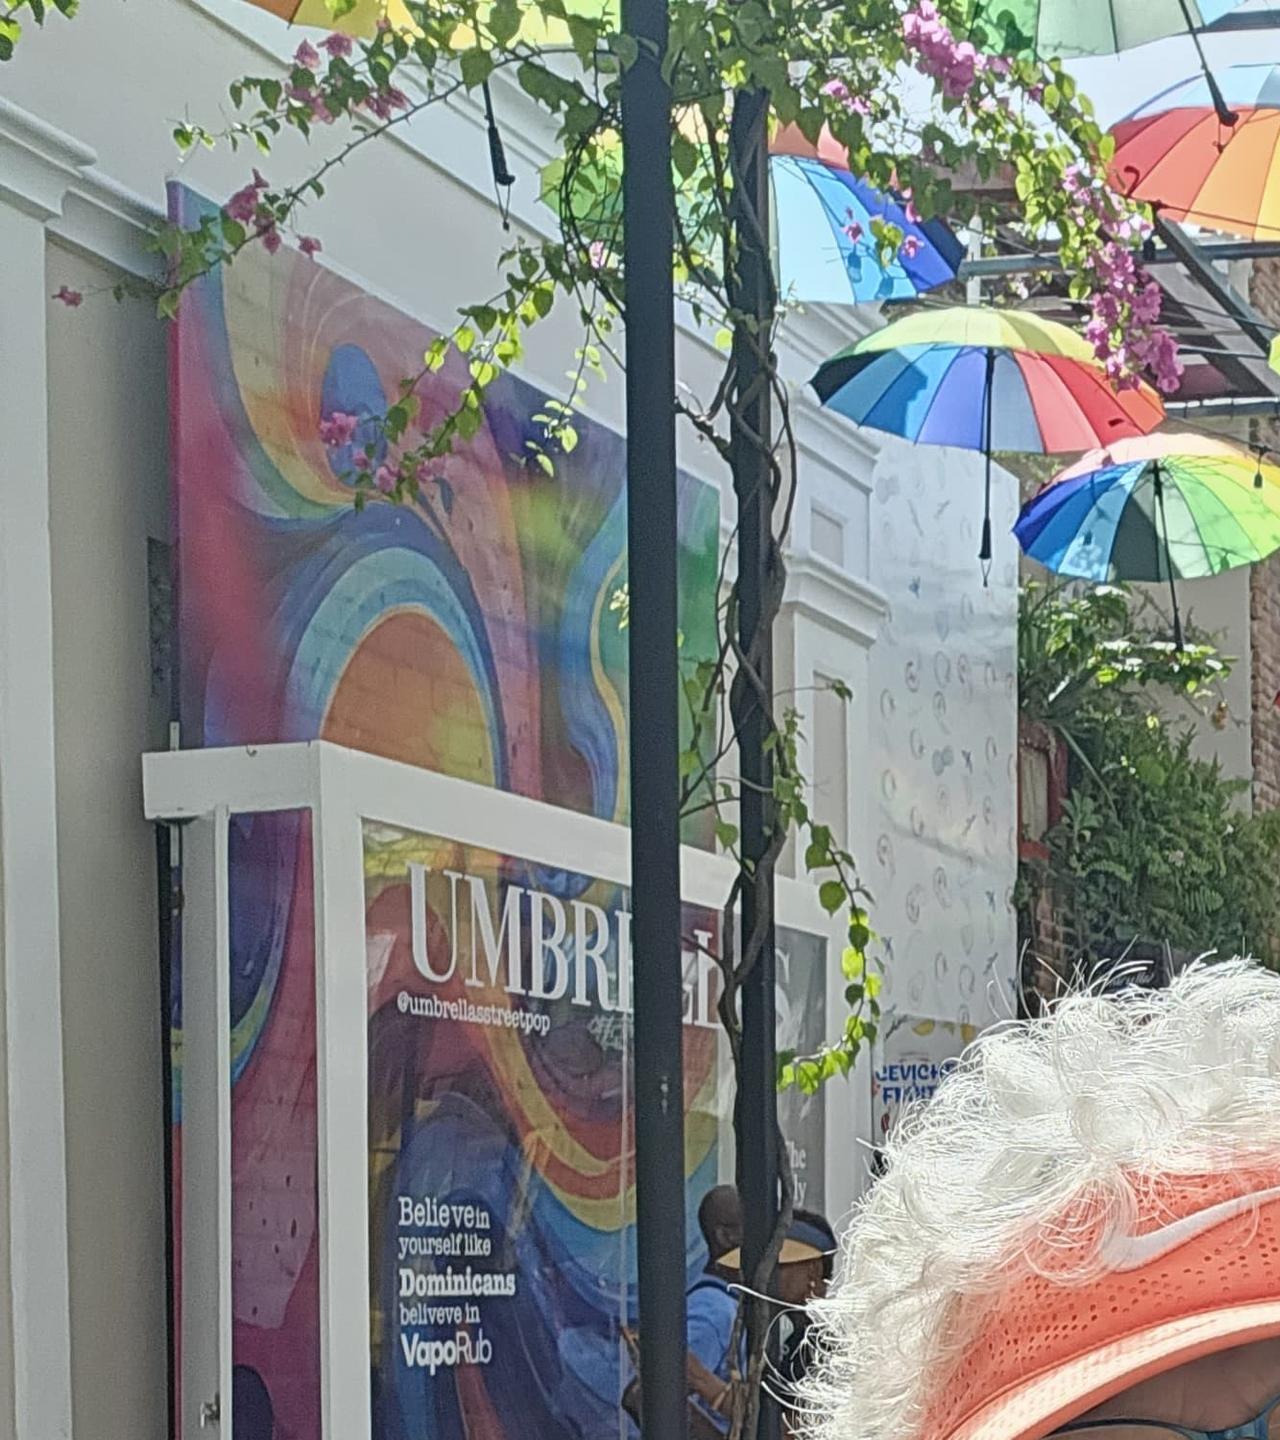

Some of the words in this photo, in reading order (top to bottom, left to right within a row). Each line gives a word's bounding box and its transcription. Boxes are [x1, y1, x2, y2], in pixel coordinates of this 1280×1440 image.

[397, 991, 550, 1036] @umbrellasstreetpop
[398, 1196, 474, 1228] Believe
[475, 1206, 490, 1229] in
[398, 1233, 462, 1260] yourself
[464, 1233, 491, 1256] like
[398, 1265, 516, 1297] Dominicans
[400, 1303, 462, 1325] beliveve
[465, 1302, 480, 1324] in
[401, 1328, 492, 1376] VapoRub
